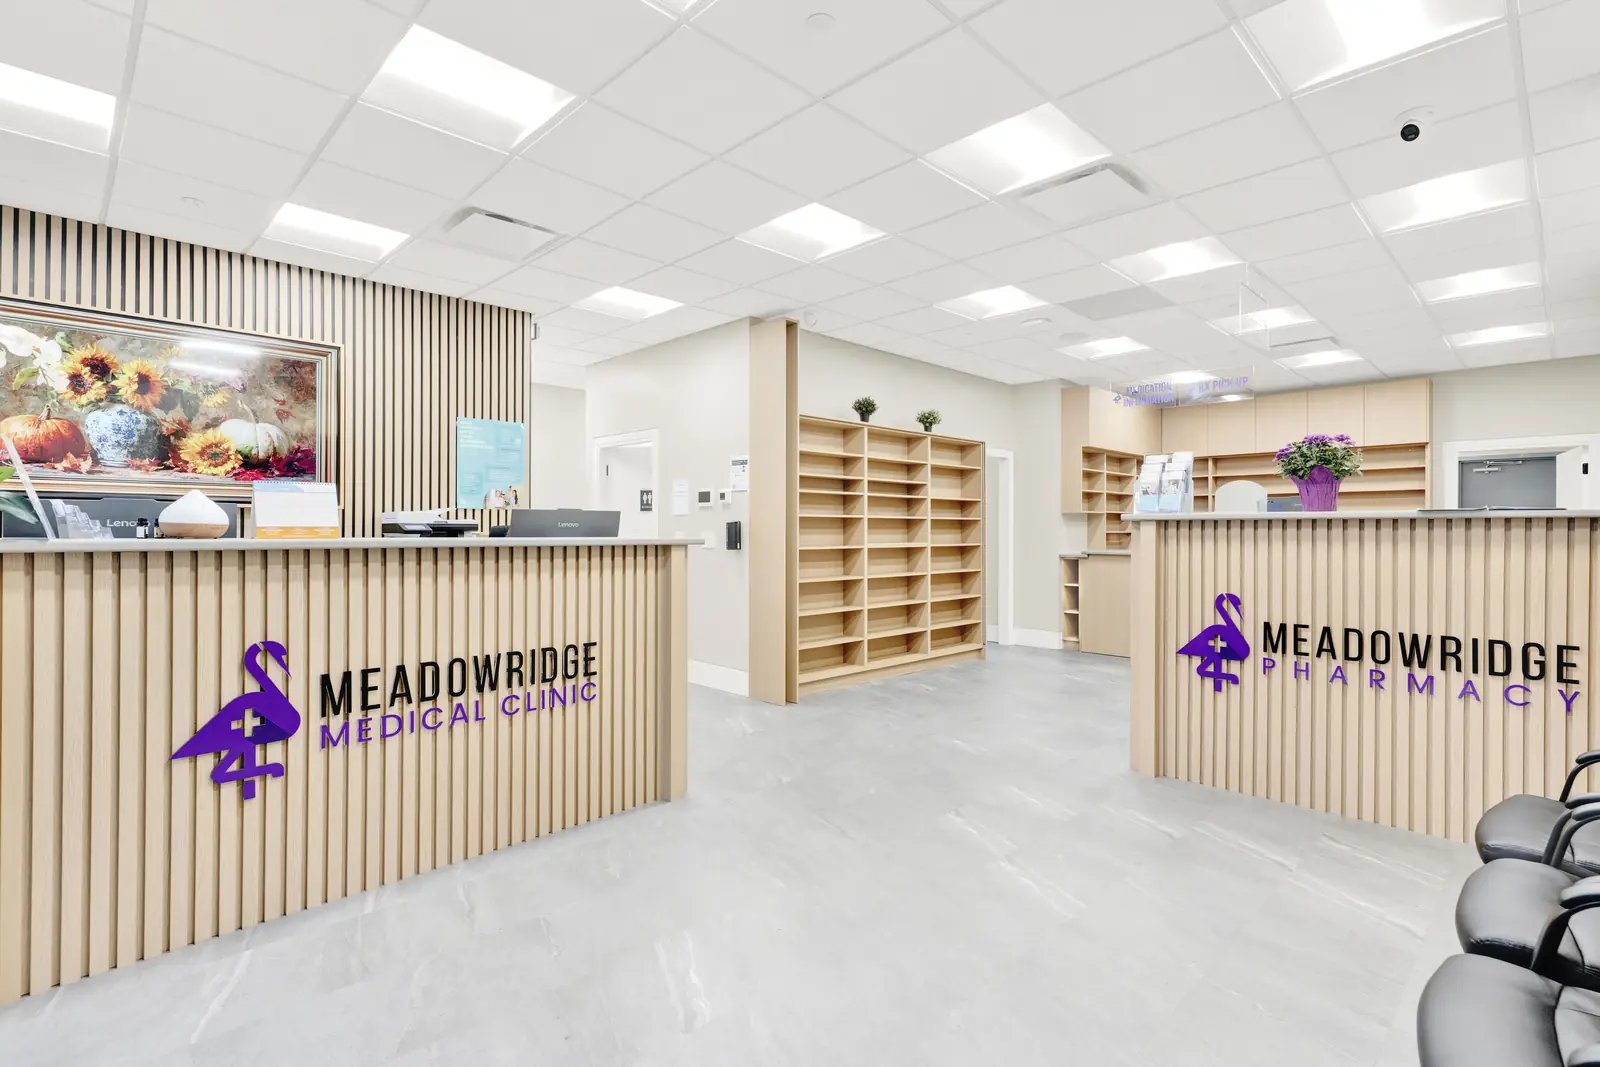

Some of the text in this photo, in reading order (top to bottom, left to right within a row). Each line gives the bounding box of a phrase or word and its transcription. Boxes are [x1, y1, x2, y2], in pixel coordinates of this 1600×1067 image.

[1126, 381, 1173, 395] MEDICATION
[1236, 376, 1249, 387] UP
[107, 519, 151, 527] Leno
[320, 641, 598, 718] MEADOWRIDGE
[1263, 621, 1580, 685] MEADOWRIDGE
[1262, 657, 1581, 713] PHARMACY
[320, 682, 598, 750] MEDICAL CLINIC
